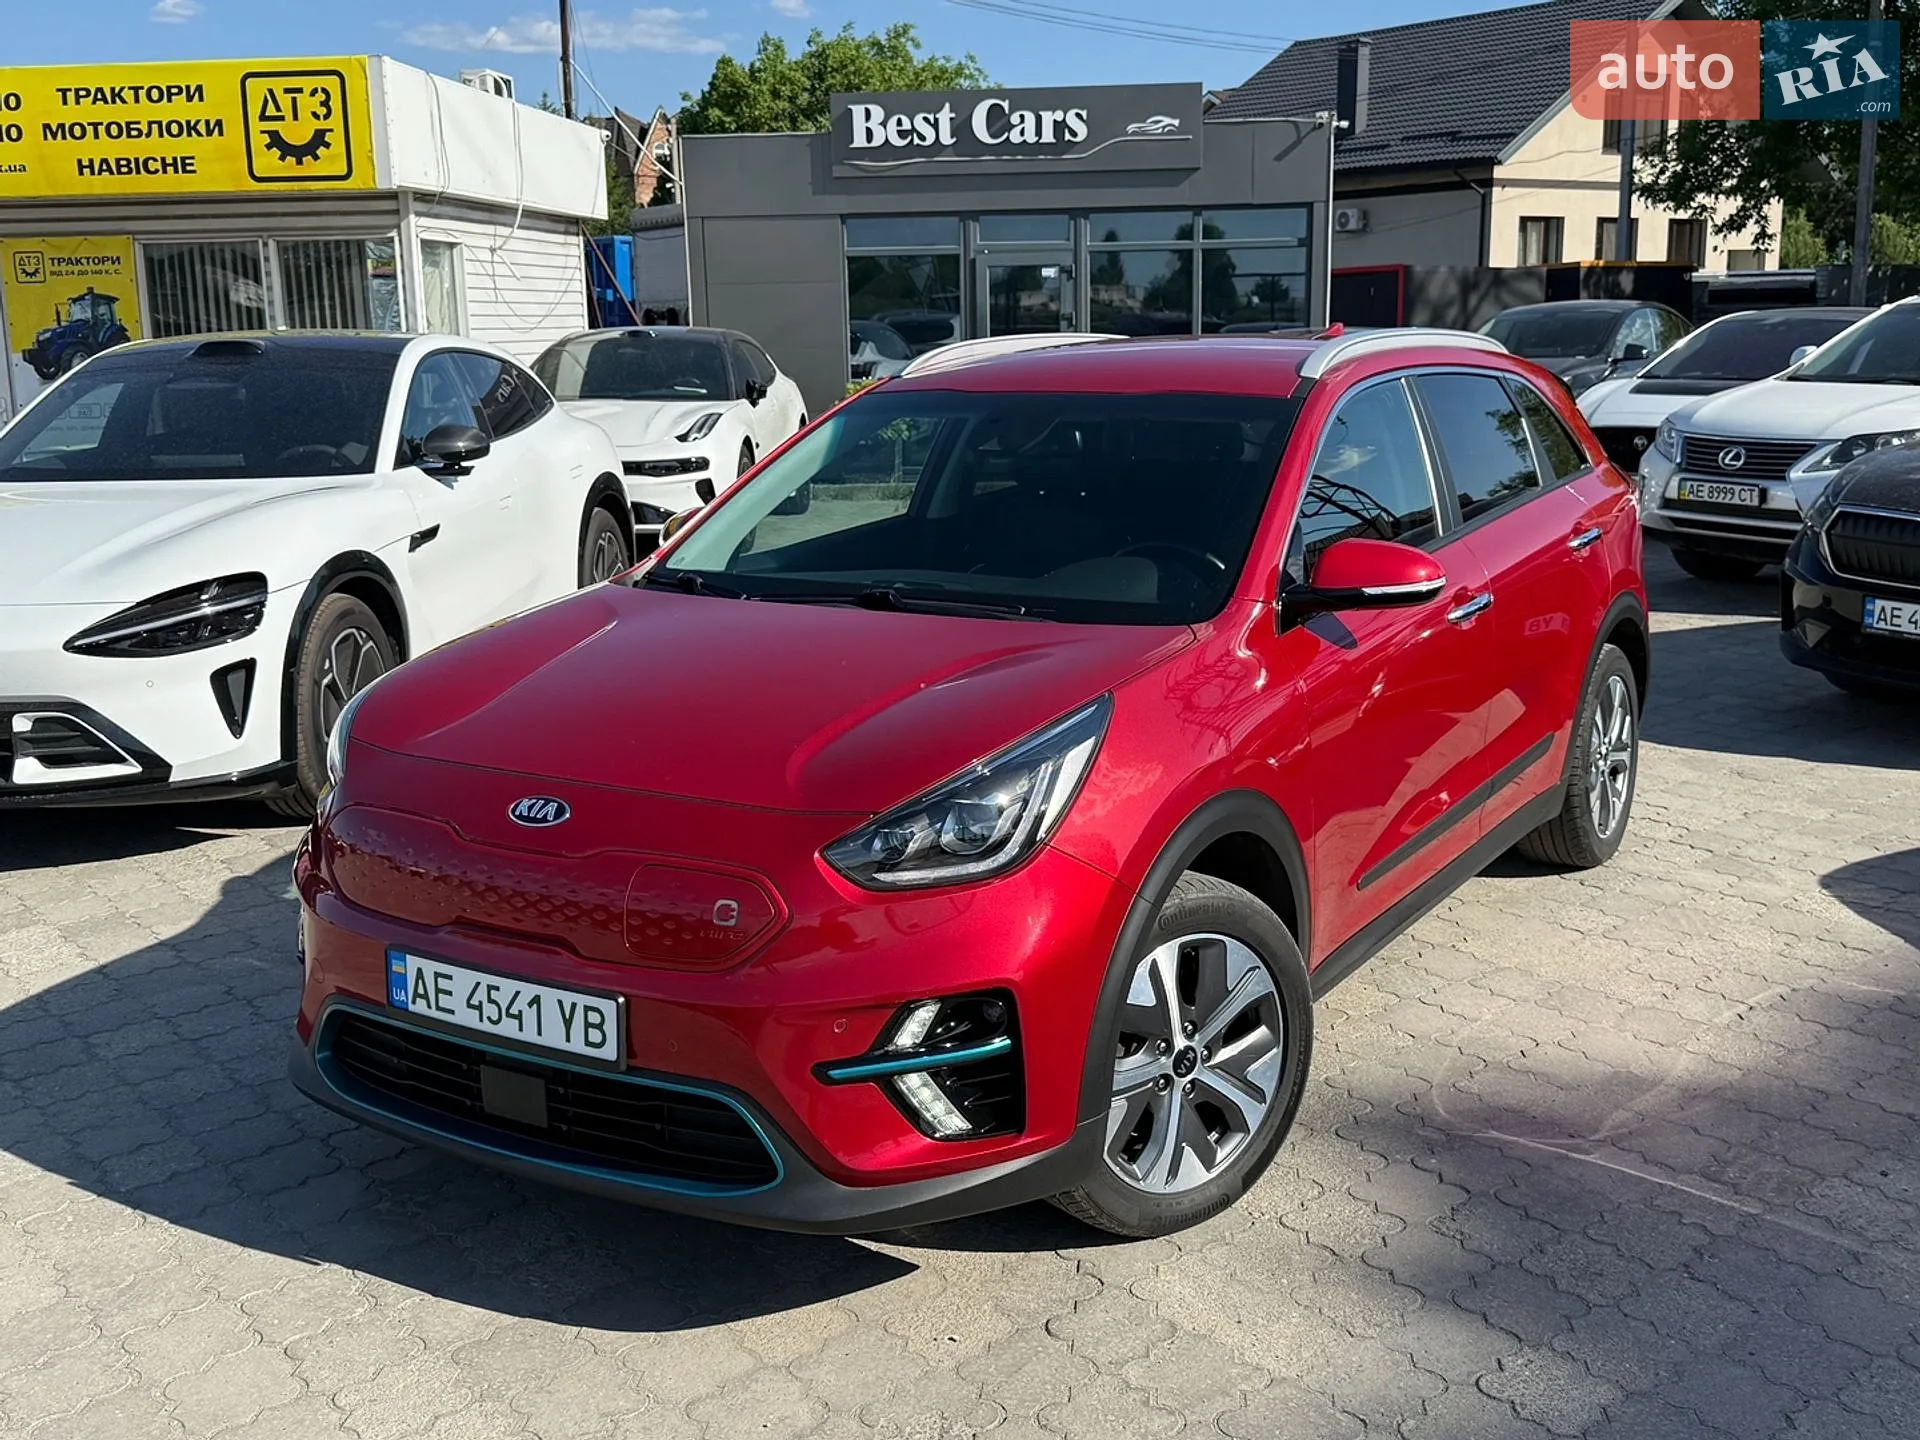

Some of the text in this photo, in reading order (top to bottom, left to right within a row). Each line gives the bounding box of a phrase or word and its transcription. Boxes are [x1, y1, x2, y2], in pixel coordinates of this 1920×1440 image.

[0, 92, 22, 112] О
[56, 84, 205, 106] ТРАКТОРИ
[42, 118, 225, 142] МОТОБЛОКИ
[847, 98, 1089, 149] Best Cars
[76, 156, 198, 177] НАВІСНЕ
[49, 255, 121, 268] ТРАКТОРИ
[1688, 484, 1756, 503] AE 8999 CT
[1875, 605, 1920, 631] AE 4
[515, 798, 558, 821] KIA
[392, 986, 408, 1003] UA
[411, 966, 607, 1050] AE 4541 YB
